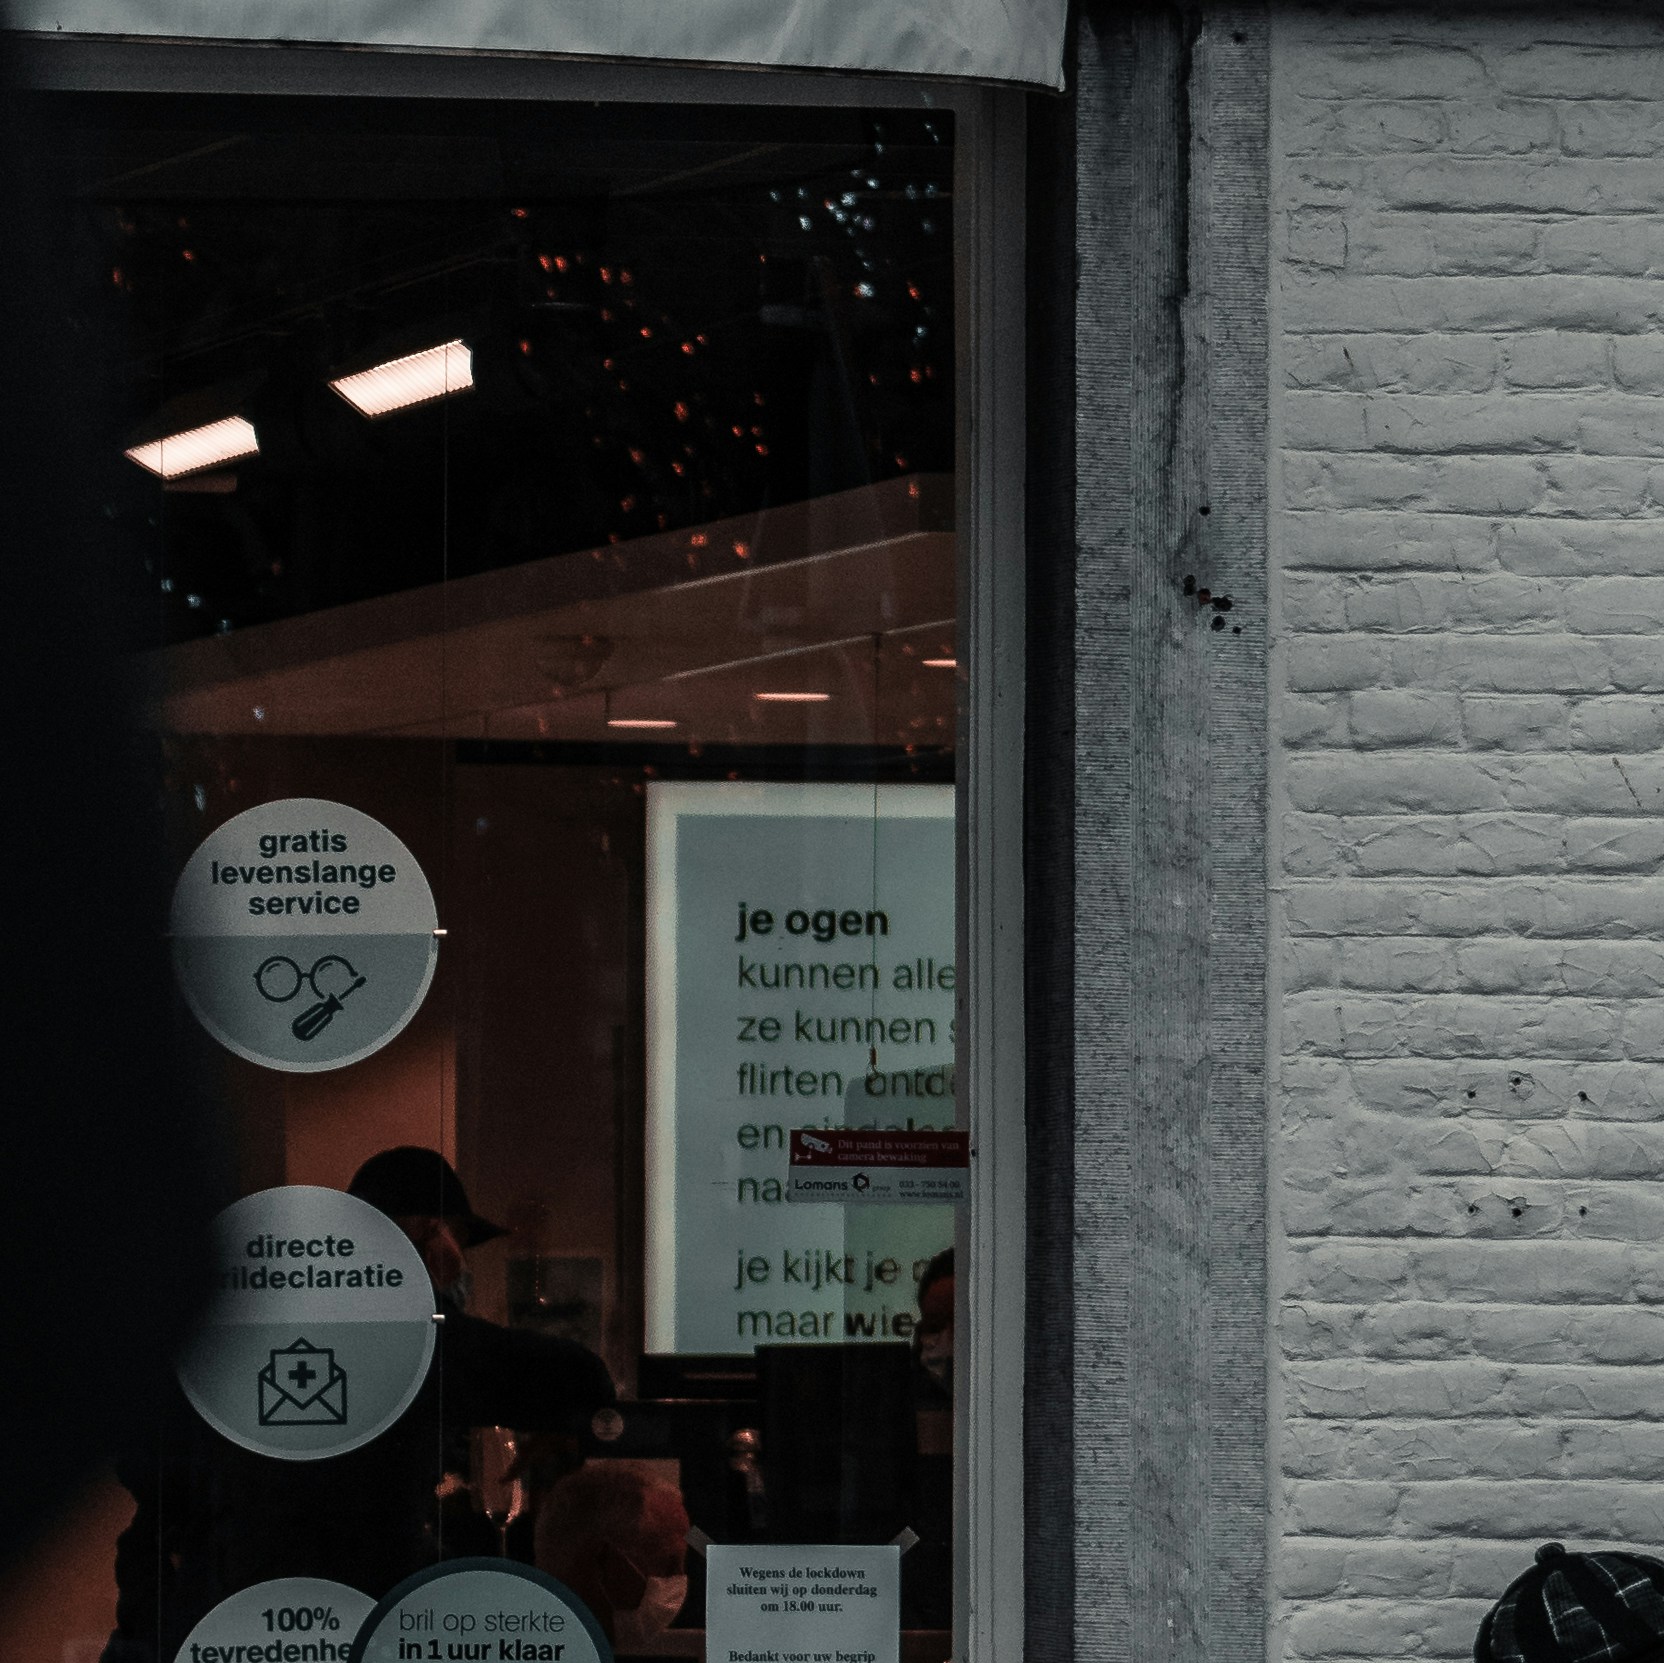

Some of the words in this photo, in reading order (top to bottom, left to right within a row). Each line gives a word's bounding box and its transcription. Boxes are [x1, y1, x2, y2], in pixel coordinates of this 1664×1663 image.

[259, 829, 347, 858] gratis
[211, 860, 396, 888] levenslange
[249, 891, 360, 915] service
[735, 902, 773, 942] je
[786, 910, 888, 942] ogen
[738, 956, 879, 989] kunnen
[737, 1017, 781, 1042] ze
[795, 1008, 936, 1042] kunnen
[737, 1062, 842, 1096] flirten
[865, 1065, 955, 1096] ontd
[737, 1123, 783, 1149] en
[837, 1140, 853, 1150] Dit
[856, 1140, 882, 1152] pand
[884, 1140, 892, 1150] is
[894, 1140, 939, 1150] voorzien
[941, 1142, 959, 1150] van
[837, 1153, 875, 1162] camera
[877, 1152, 927, 1164] bewaking
[795, 1178, 848, 1191] Lomans
[246, 1235, 354, 1258] directe
[220, 1264, 403, 1290] rildeclaratie
[734, 1249, 770, 1290] je
[784, 1249, 854, 1291] kijkt
[864, 1251, 900, 1291] je
[738, 1311, 834, 1337] maar
[846, 1305, 914, 1336] wie
[739, 1567, 786, 1581] Wegens
[788, 1567, 802, 1578] de
[805, 1567, 865, 1578] lockdown
[727, 1584, 767, 1595] sluiten
[770, 1584, 789, 1597] wij
[792, 1586, 807, 1598] op
[811, 1584, 878, 1597] donderdag
[760, 1603, 779, 1612] om
[783, 1601, 814, 1612] 18.00
[818, 1603, 843, 1612] uur.
[261, 1607, 340, 1632] 100%
[400, 1609, 433, 1631] bril
[443, 1614, 476, 1636] op
[484, 1610, 565, 1633] sterkte
[399, 1638, 422, 1660] in
[428, 1639, 442, 1660] 1
[448, 1642, 491, 1660] uur
[499, 1639, 565, 1661] klaar
[729, 1650, 779, 1662] Bedankt
[783, 1653, 810, 1662] voor
[813, 1653, 832, 1662] uw
[835, 1650, 876, 1663] begrip
